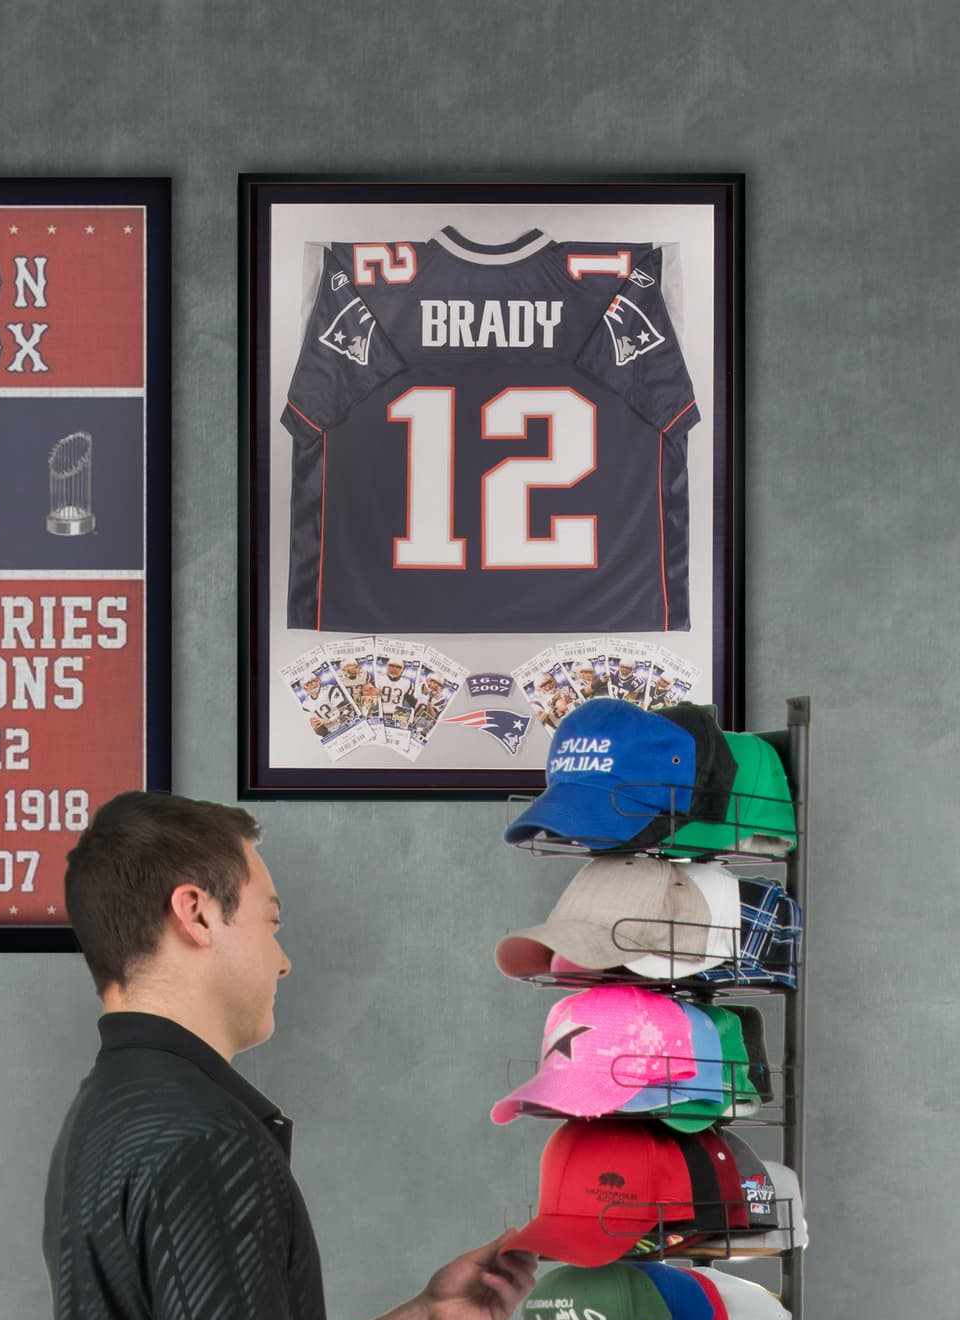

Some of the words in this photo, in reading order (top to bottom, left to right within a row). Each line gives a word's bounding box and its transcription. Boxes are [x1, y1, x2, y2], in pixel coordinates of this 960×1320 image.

[420, 299, 564, 348] BRADY
[386, 386, 598, 570] 12
[382, 685, 403, 705] 93
[470, 677, 510, 686] 16-0
[470, 685, 510, 693] 2007
[4, 789, 90, 832] 1918
